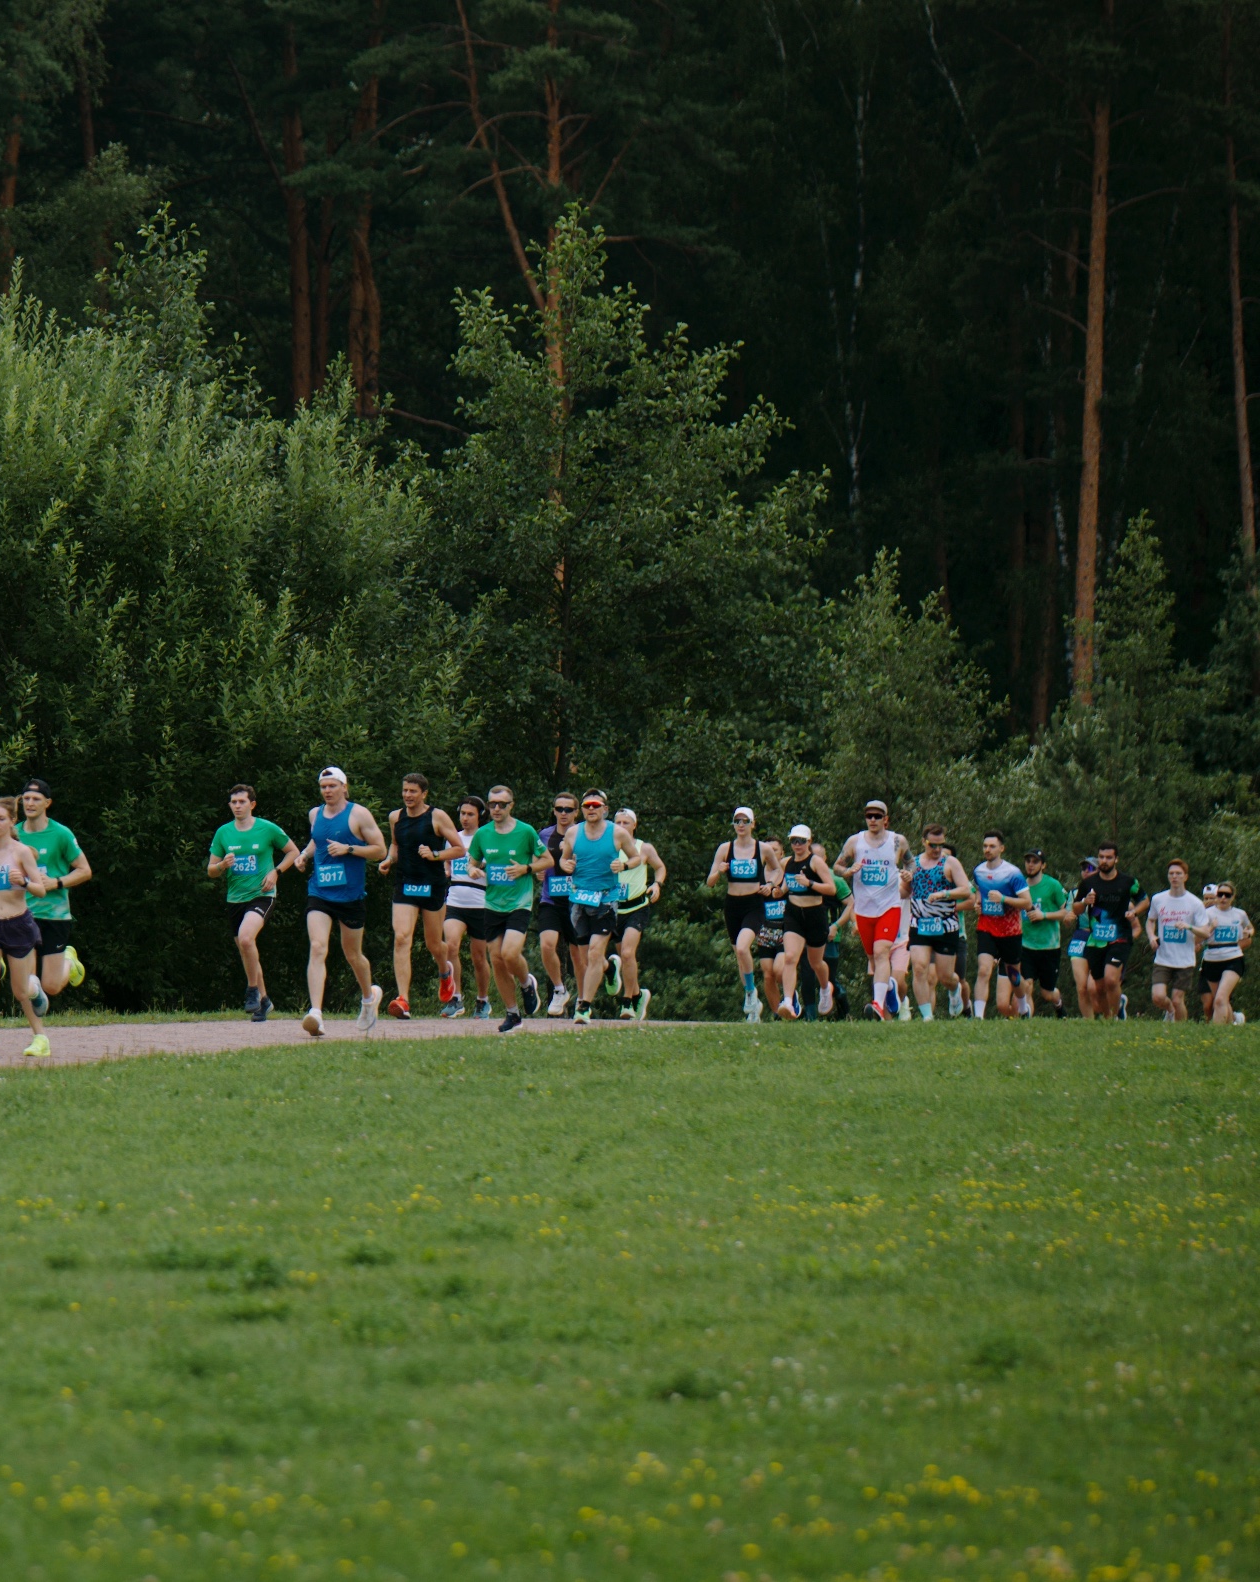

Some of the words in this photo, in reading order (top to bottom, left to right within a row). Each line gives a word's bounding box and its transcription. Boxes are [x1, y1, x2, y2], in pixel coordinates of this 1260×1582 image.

[233, 862, 256, 871] 2625
[733, 866, 755, 874] 3523
[319, 871, 343, 882] 3017
[863, 872, 886, 882] 3290
[920, 923, 942, 932] 3109
